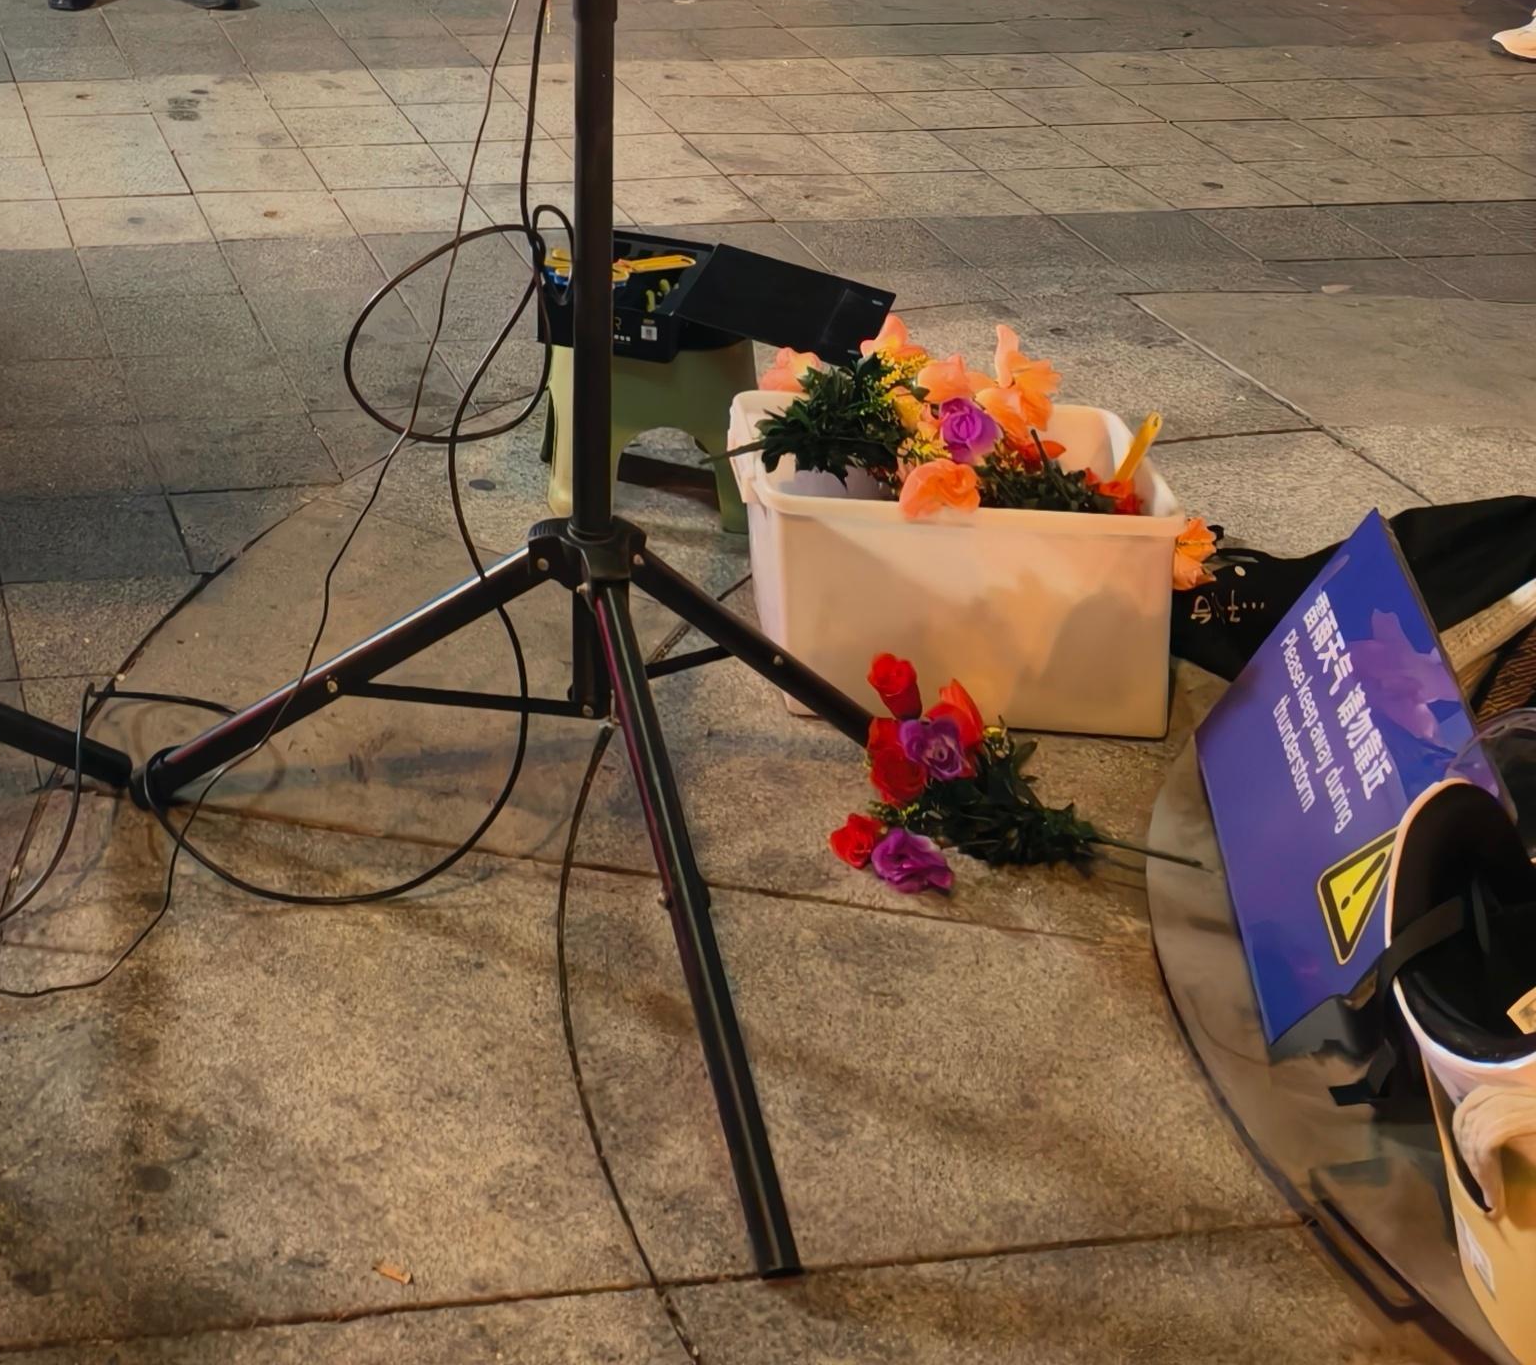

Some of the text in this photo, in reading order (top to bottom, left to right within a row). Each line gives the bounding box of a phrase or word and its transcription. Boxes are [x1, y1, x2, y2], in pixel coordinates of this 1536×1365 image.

[1273, 694, 1316, 813] thunderstorm
[1280, 628, 1353, 834] Please keep away during
[1303, 591, 1392, 800] 雷雨天气 请勿靠近
